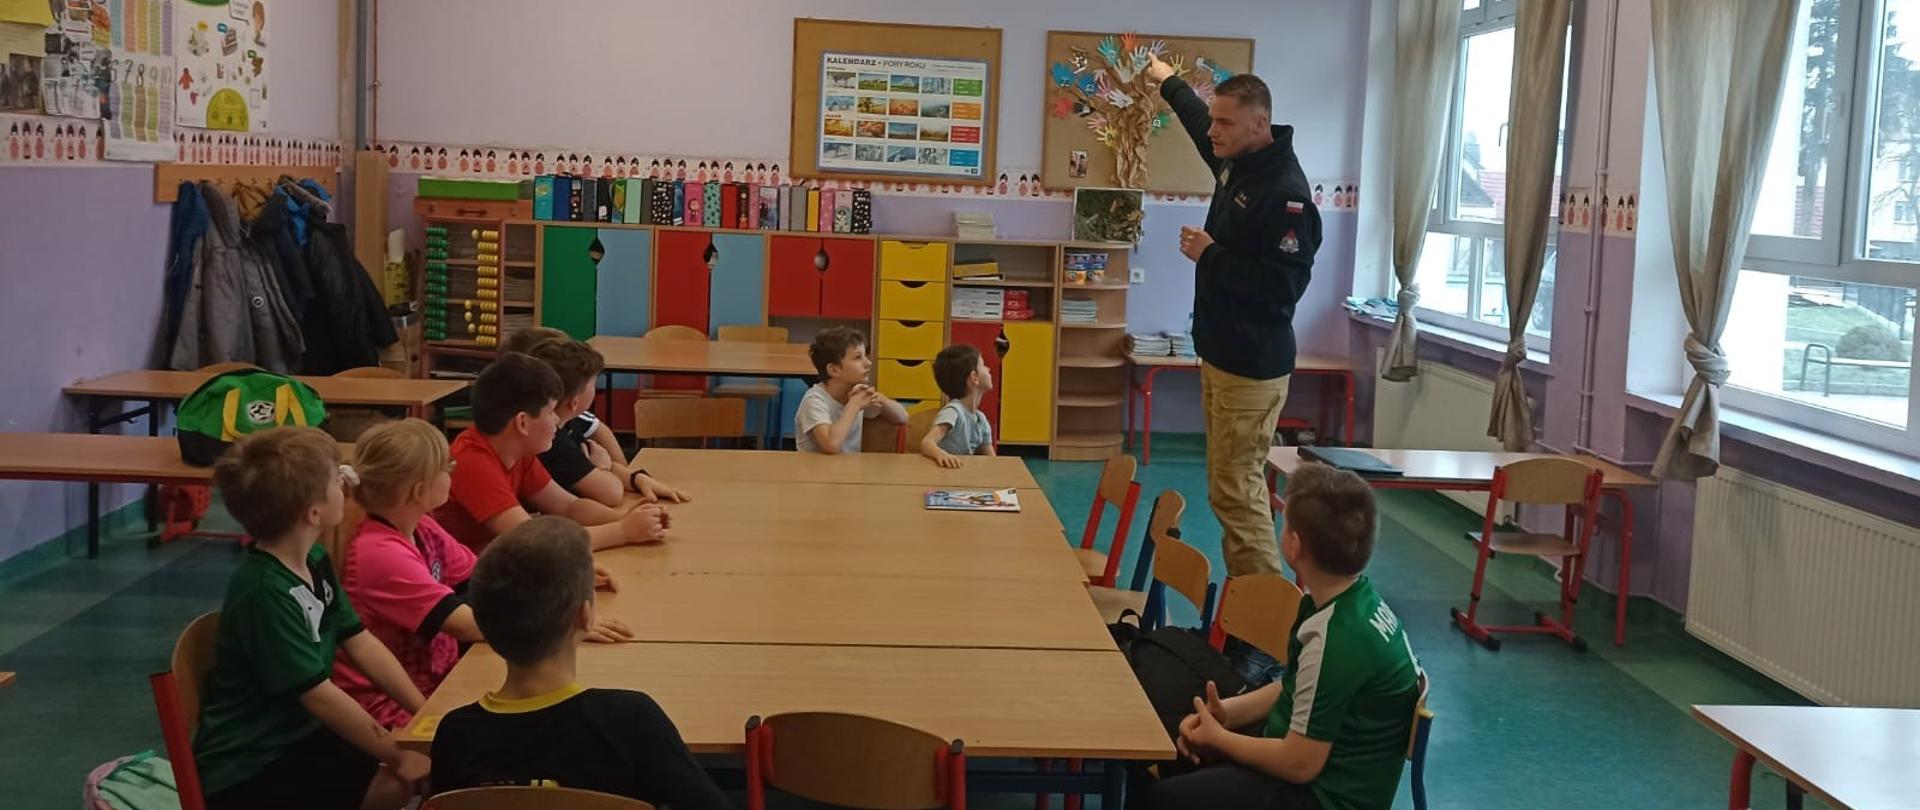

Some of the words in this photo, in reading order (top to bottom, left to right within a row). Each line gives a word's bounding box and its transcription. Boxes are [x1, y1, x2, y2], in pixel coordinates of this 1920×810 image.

[125, 59, 134, 84] 7
[137, 63, 145, 87] 8
[827, 57, 877, 67] KALENDARZ
[883, 60, 904, 68] PORY
[904, 61, 926, 69] ROKU
